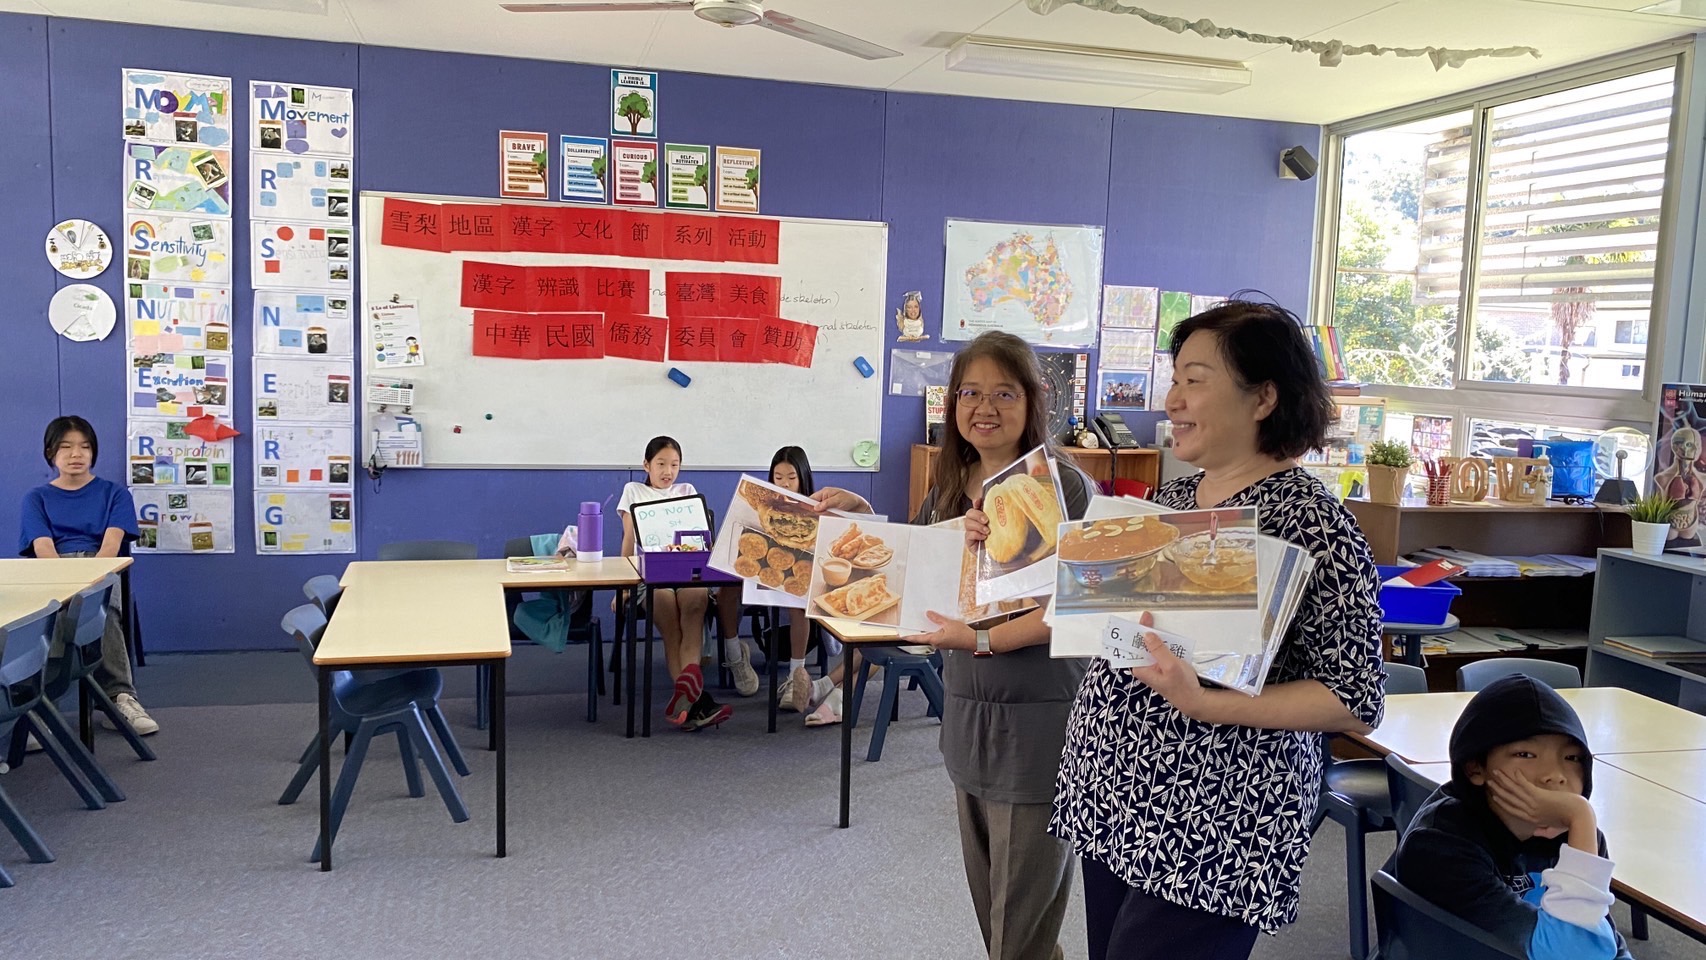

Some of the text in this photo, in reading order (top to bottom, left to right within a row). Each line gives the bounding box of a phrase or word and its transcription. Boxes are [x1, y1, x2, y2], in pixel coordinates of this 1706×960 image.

[261, 99, 350, 124] Movement
[512, 143, 536, 151] BRAVE
[134, 230, 207, 267] Sensitivity
[638, 505, 694, 520] DO NOT
[1110, 627, 1123, 641] 6.
[1113, 647, 1126, 659] 4.
